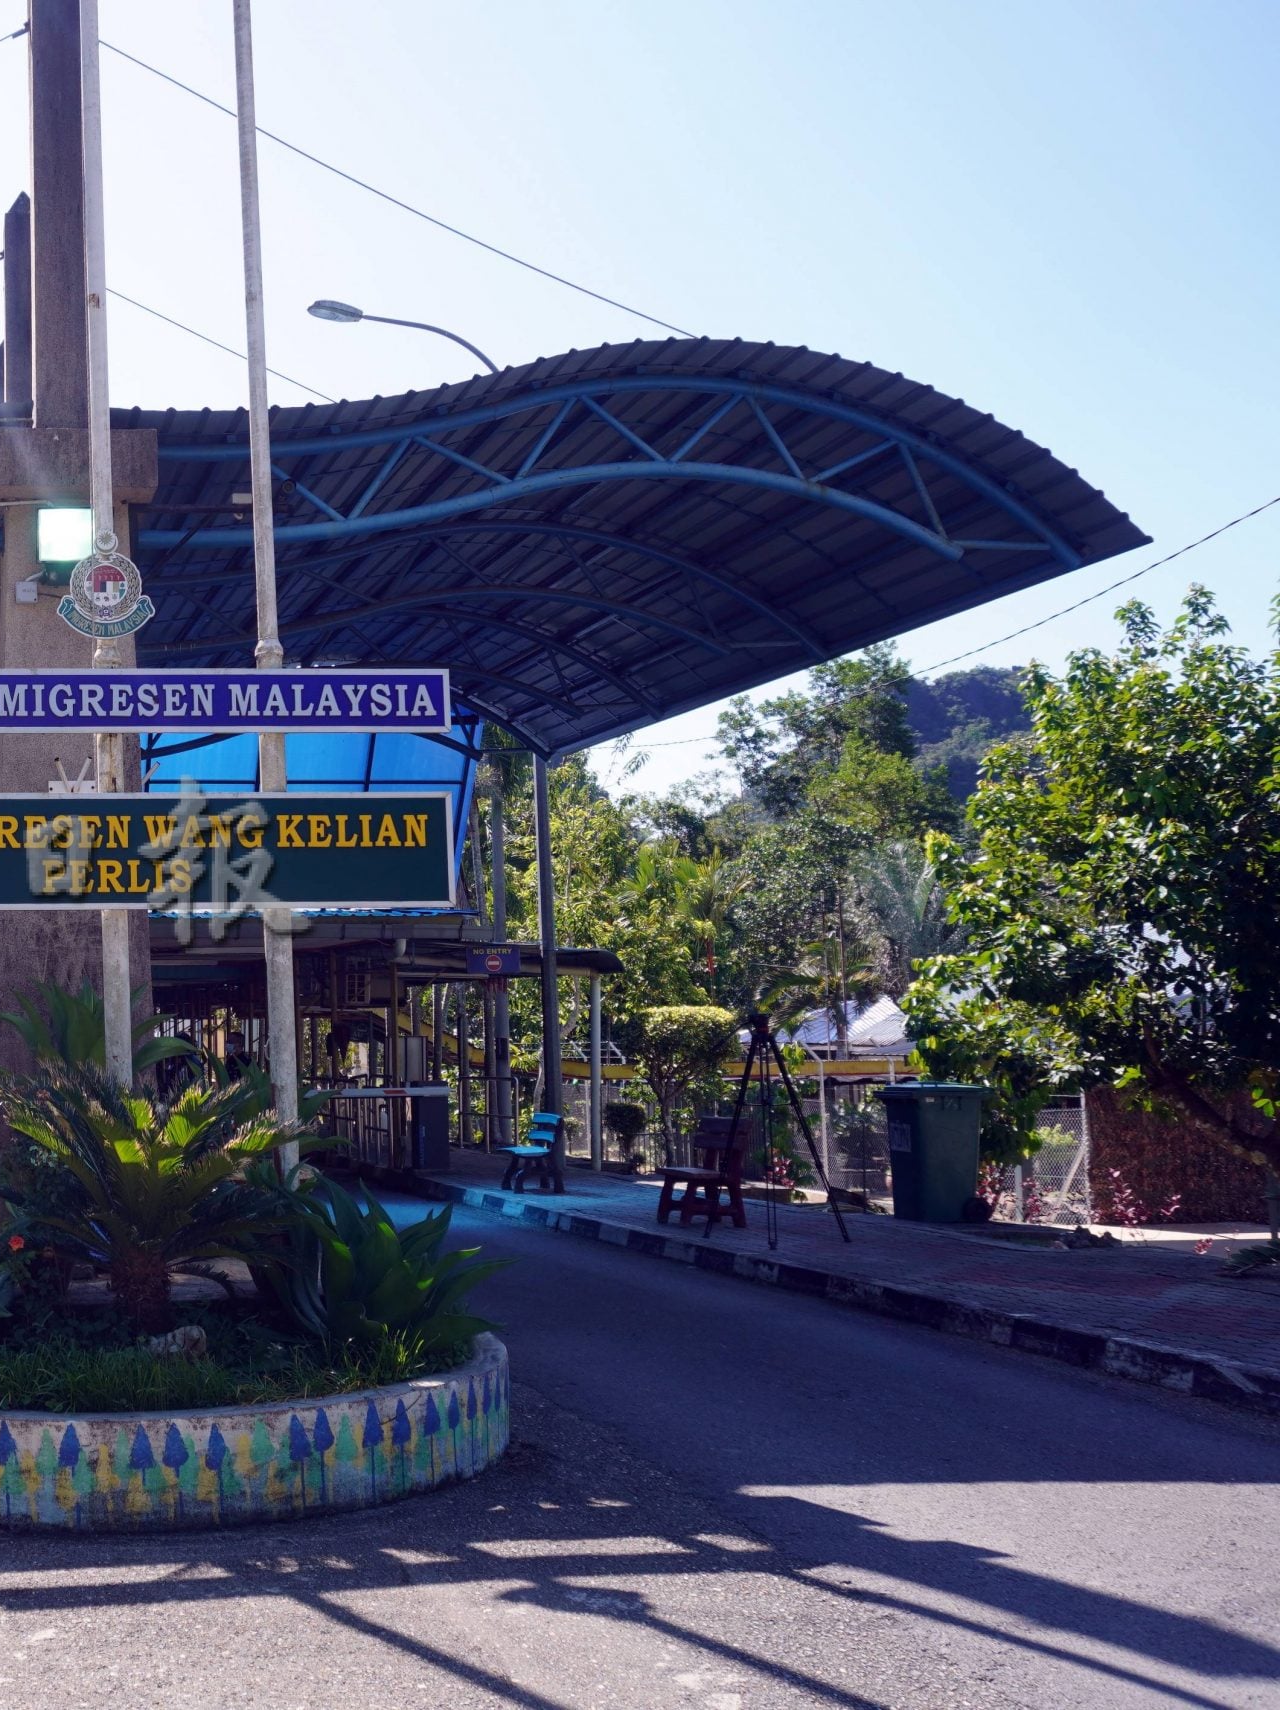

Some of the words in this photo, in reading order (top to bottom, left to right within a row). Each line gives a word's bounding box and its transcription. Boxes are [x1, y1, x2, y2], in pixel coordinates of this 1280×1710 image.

[107, 609, 147, 636] MALAYSIA
[227, 683, 437, 718] MALAYSIA
[142, 814, 265, 850] WANG
[276, 813, 428, 849] KELIAN
[42, 858, 193, 894] PERLIS
